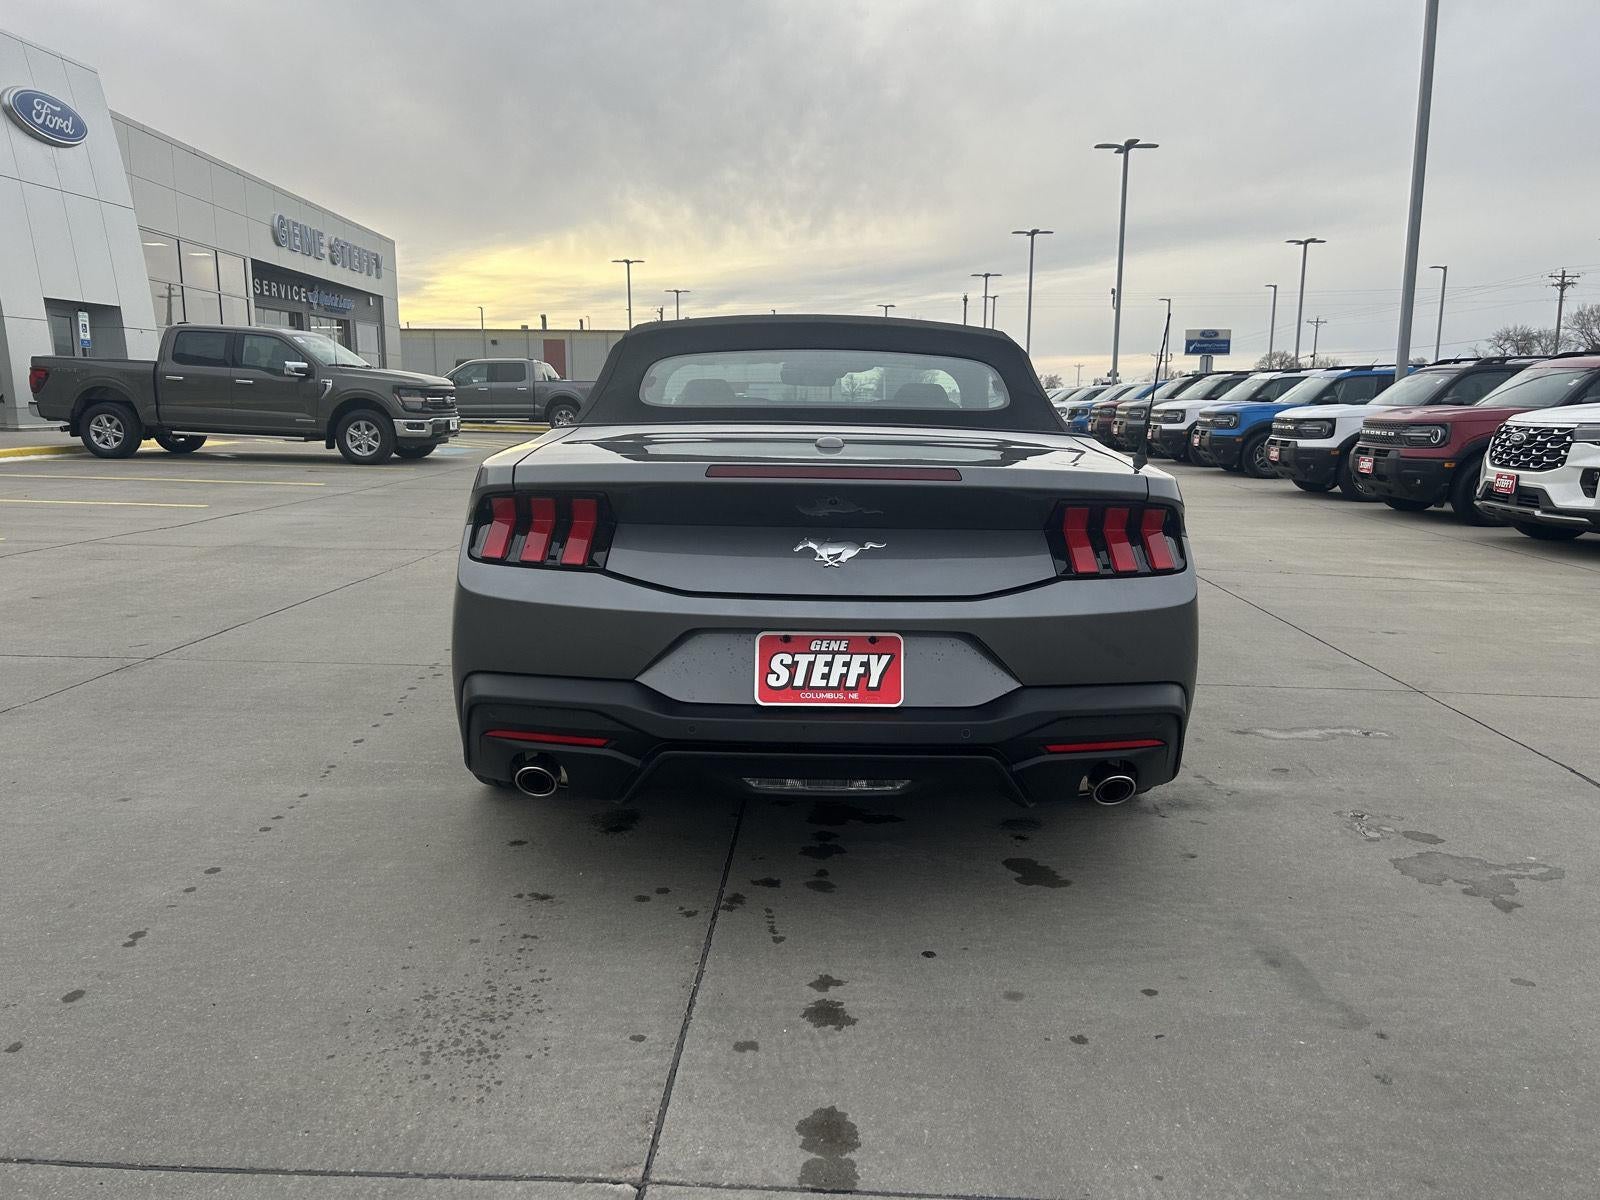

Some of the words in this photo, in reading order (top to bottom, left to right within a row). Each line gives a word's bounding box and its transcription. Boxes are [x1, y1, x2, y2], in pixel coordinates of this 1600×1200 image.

[32, 98, 75, 135] Ford
[272, 213, 326, 260] GENE
[329, 236, 383, 280] STEFFY
[254, 278, 307, 303] SERVICE
[1361, 429, 1395, 437] BRONCO
[810, 639, 849, 651] GENE
[766, 652, 892, 688] STEFFY
[800, 692, 846, 700] COLUMBUS,
[848, 692, 860, 700] NE
